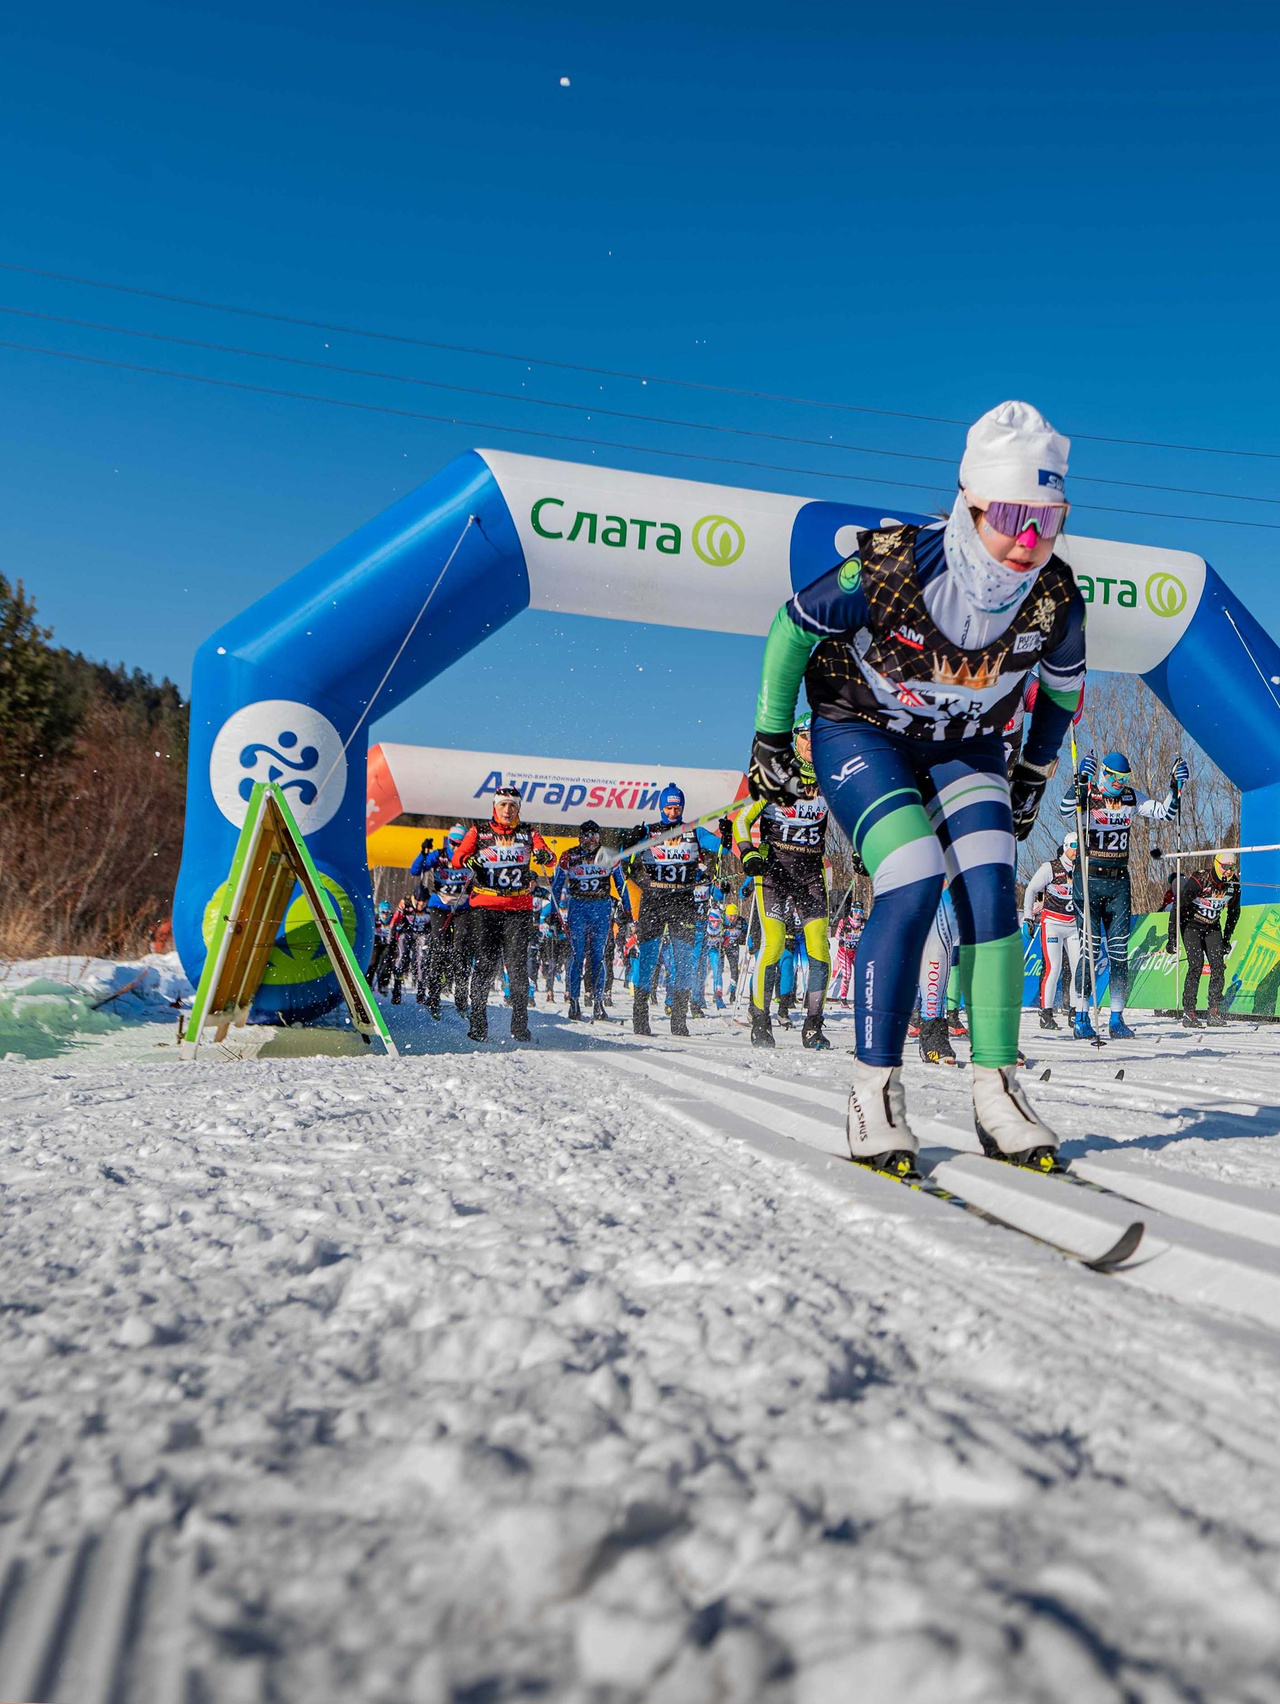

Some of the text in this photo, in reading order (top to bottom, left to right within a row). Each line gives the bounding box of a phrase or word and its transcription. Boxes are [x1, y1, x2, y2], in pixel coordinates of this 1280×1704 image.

[530, 496, 682, 555] Слата
[1076, 573, 1138, 608] ата
[582, 778, 617, 786] КОМПЛЕКС
[798, 811, 823, 820] LAND
[780, 824, 820, 846] 145
[1096, 831, 1128, 851] 128
[500, 854, 525, 863] LAND
[667, 853, 691, 861] LAND
[487, 868, 523, 888] 162
[655, 865, 687, 883] 131
[579, 879, 600, 892] 59
[864, 960, 876, 1050] VICTORY CODE
[850, 1084, 869, 1143] MADSHUS
